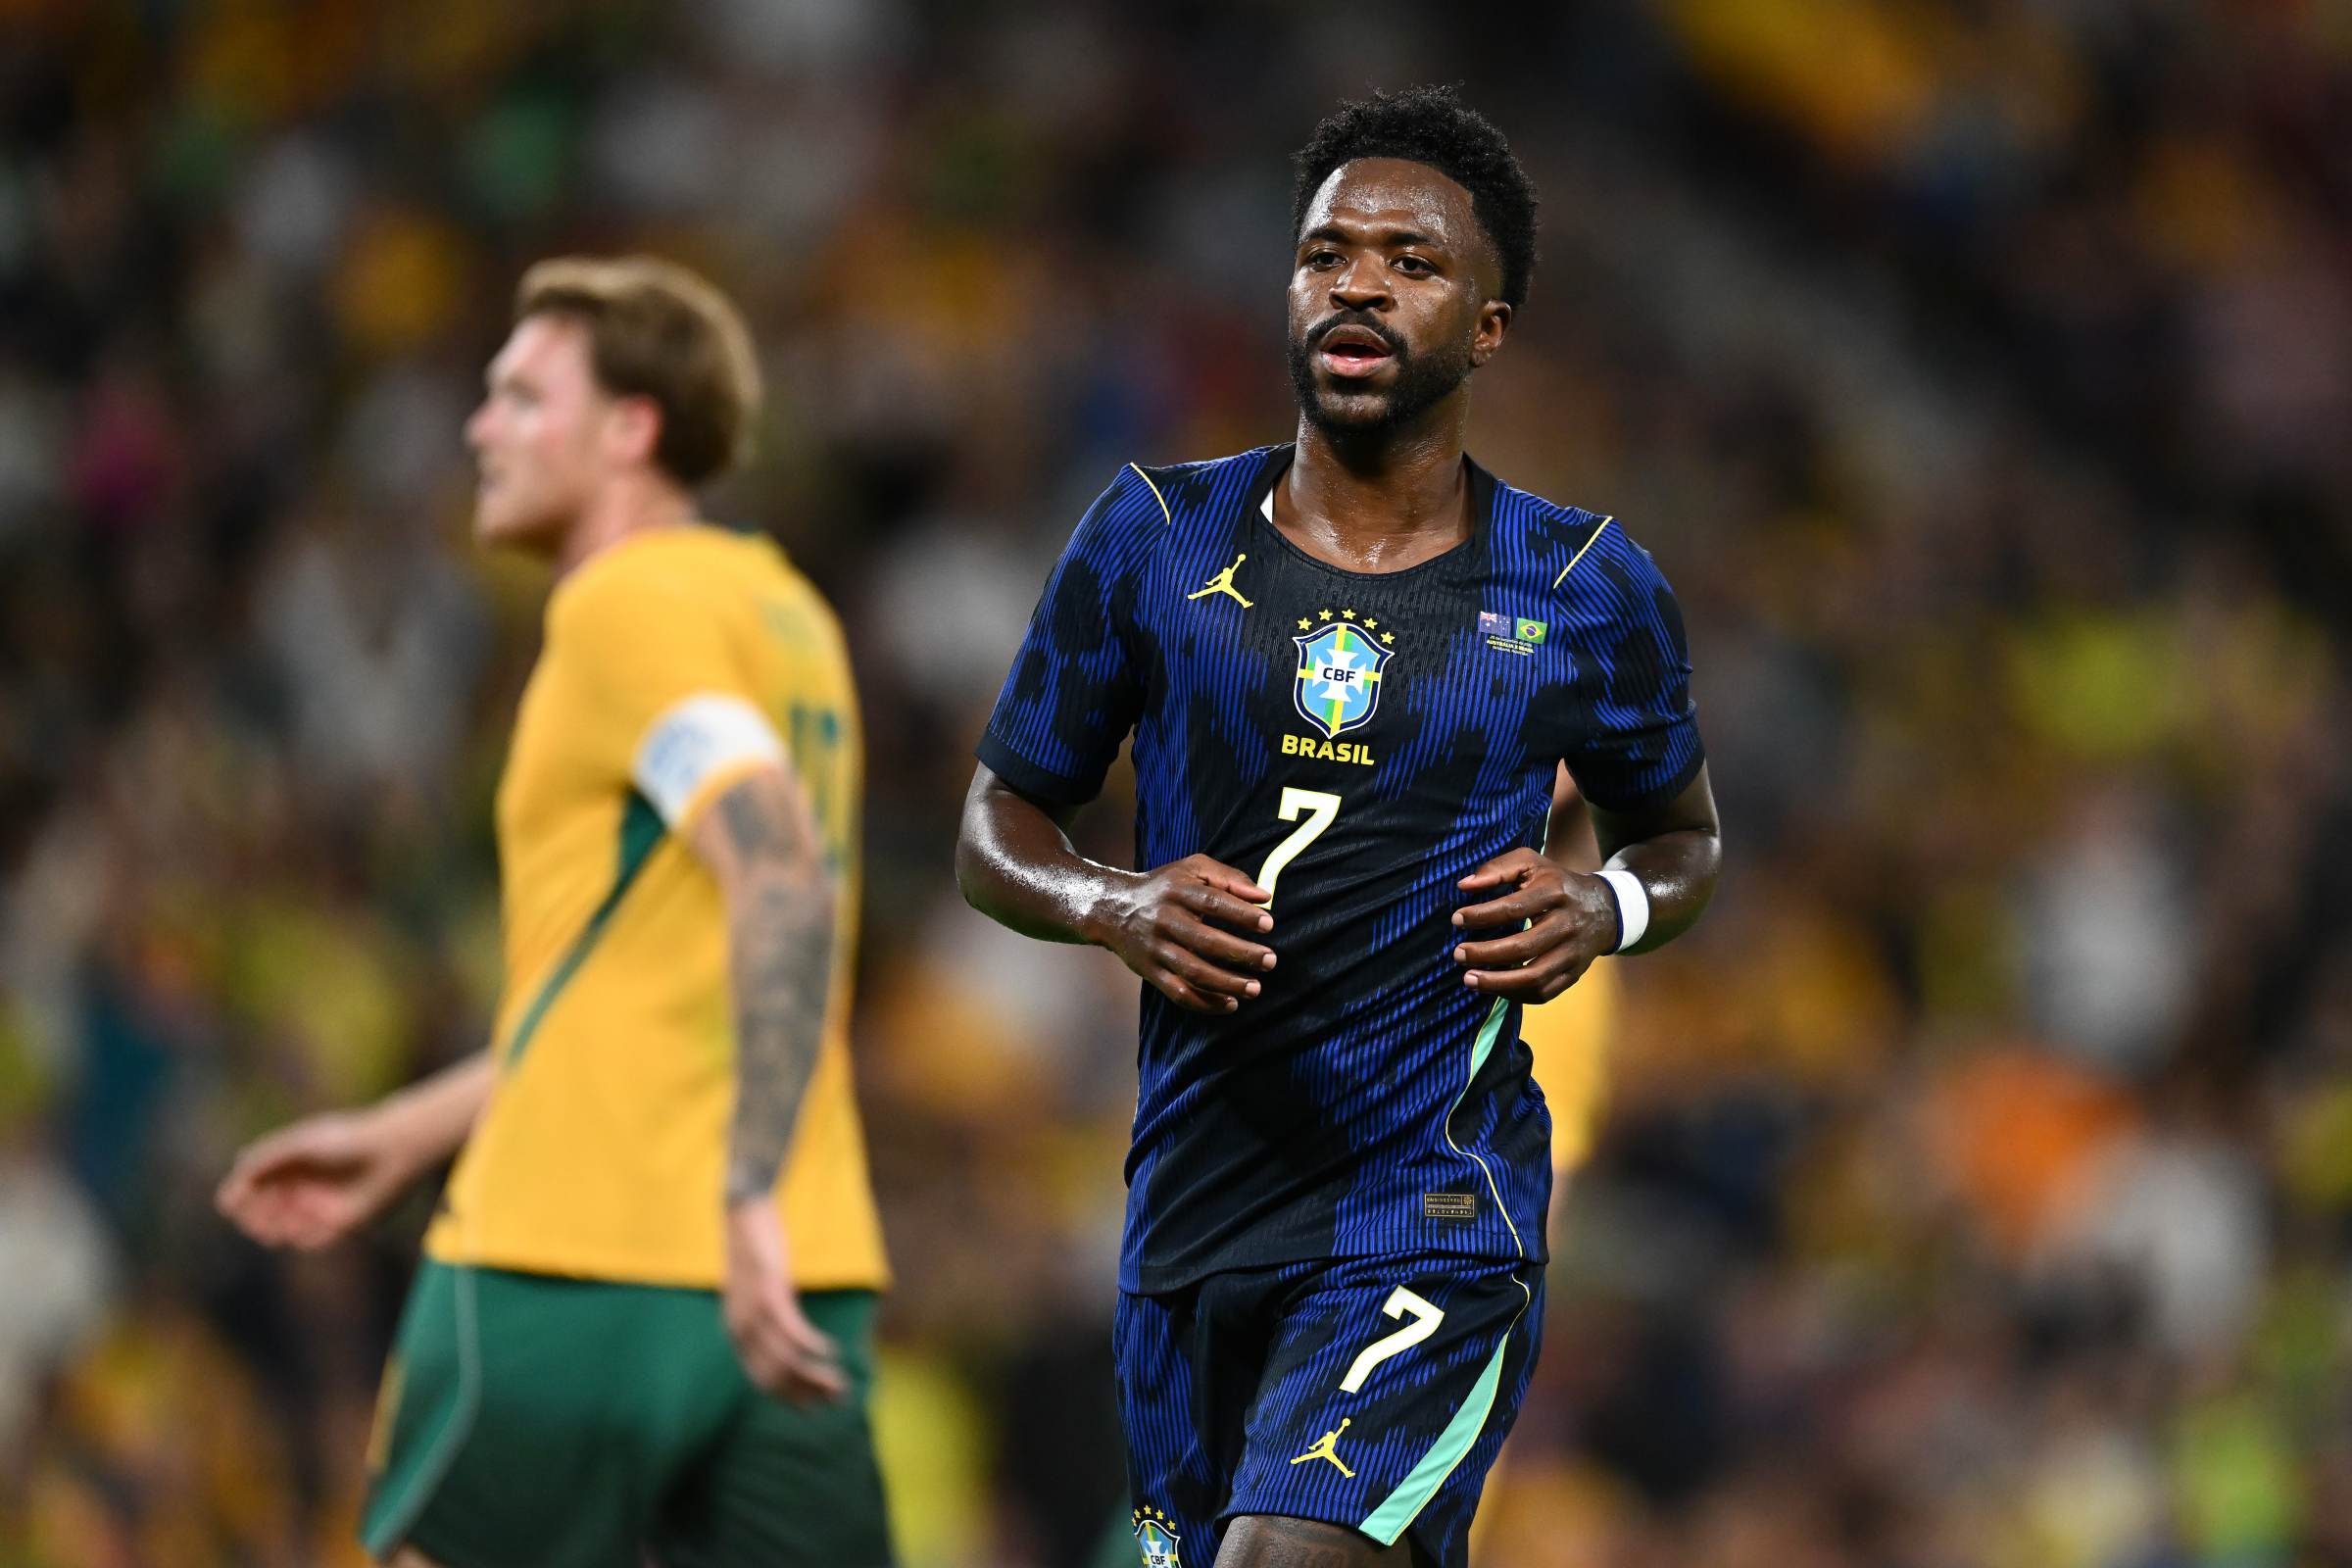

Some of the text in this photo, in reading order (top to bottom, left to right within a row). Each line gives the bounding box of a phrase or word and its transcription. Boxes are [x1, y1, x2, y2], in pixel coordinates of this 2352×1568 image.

[1322, 666, 1356, 683] CBF
[1281, 734, 1375, 765] BRASIL
[1254, 786, 1343, 910] 7
[1338, 1284, 1446, 1395] 7
[1150, 1554, 1165, 1565] CBF
